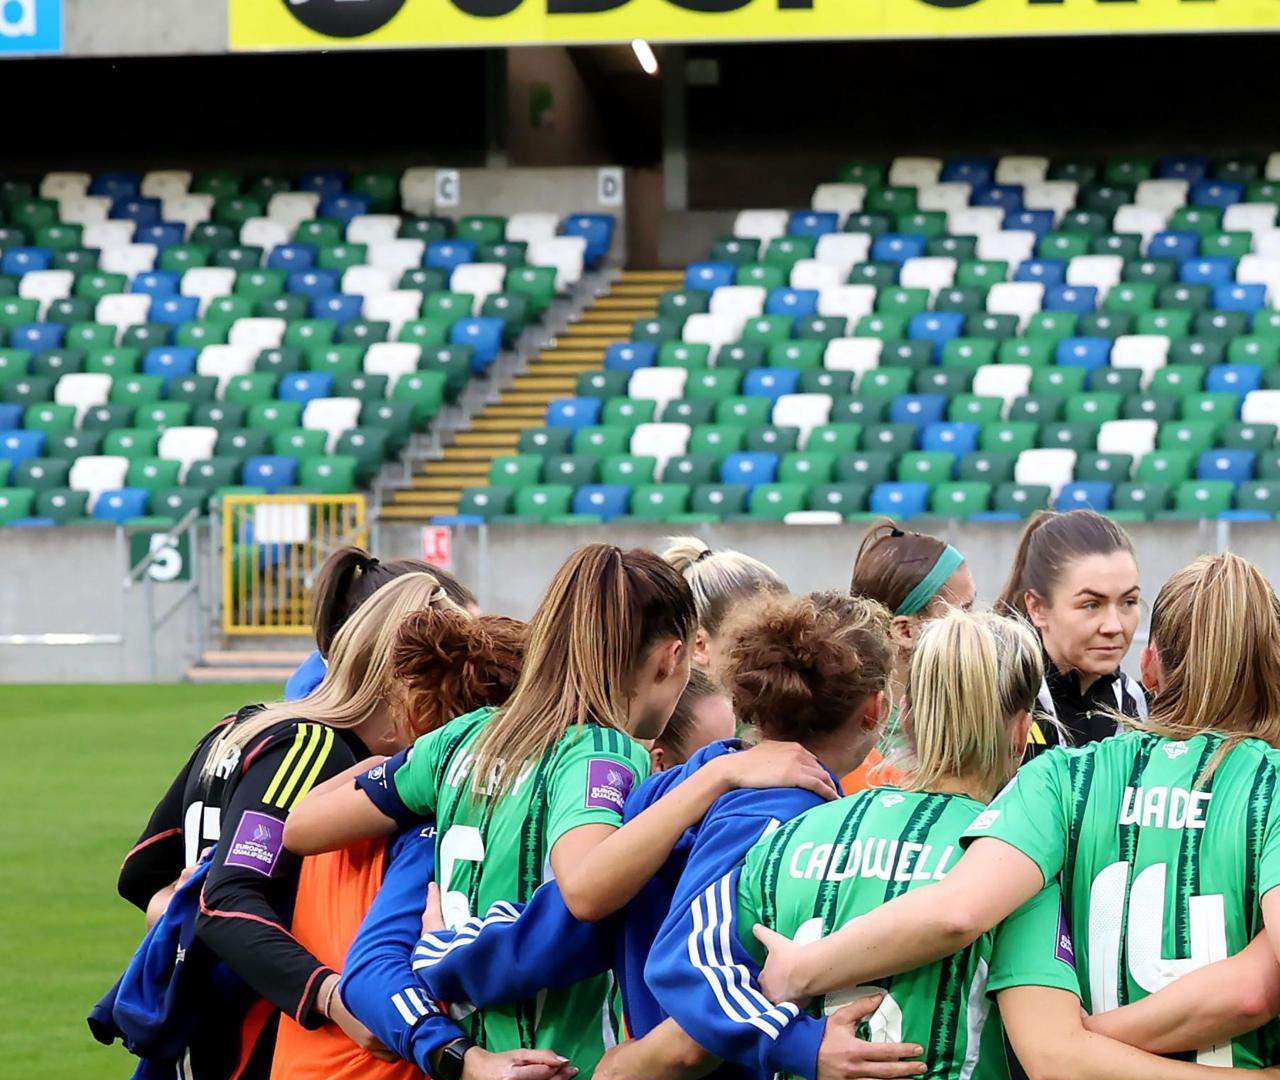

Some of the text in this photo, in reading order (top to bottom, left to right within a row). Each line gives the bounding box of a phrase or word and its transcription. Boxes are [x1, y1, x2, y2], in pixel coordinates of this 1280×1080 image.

[149, 532, 183, 581] 5
[1119, 786, 1213, 829] WADE
[232, 849, 273, 864] QUALIFIERS
[235, 843, 274, 859] EUROPEAN
[789, 837, 954, 881] CALDWELL
[1088, 860, 1234, 1068] 14
